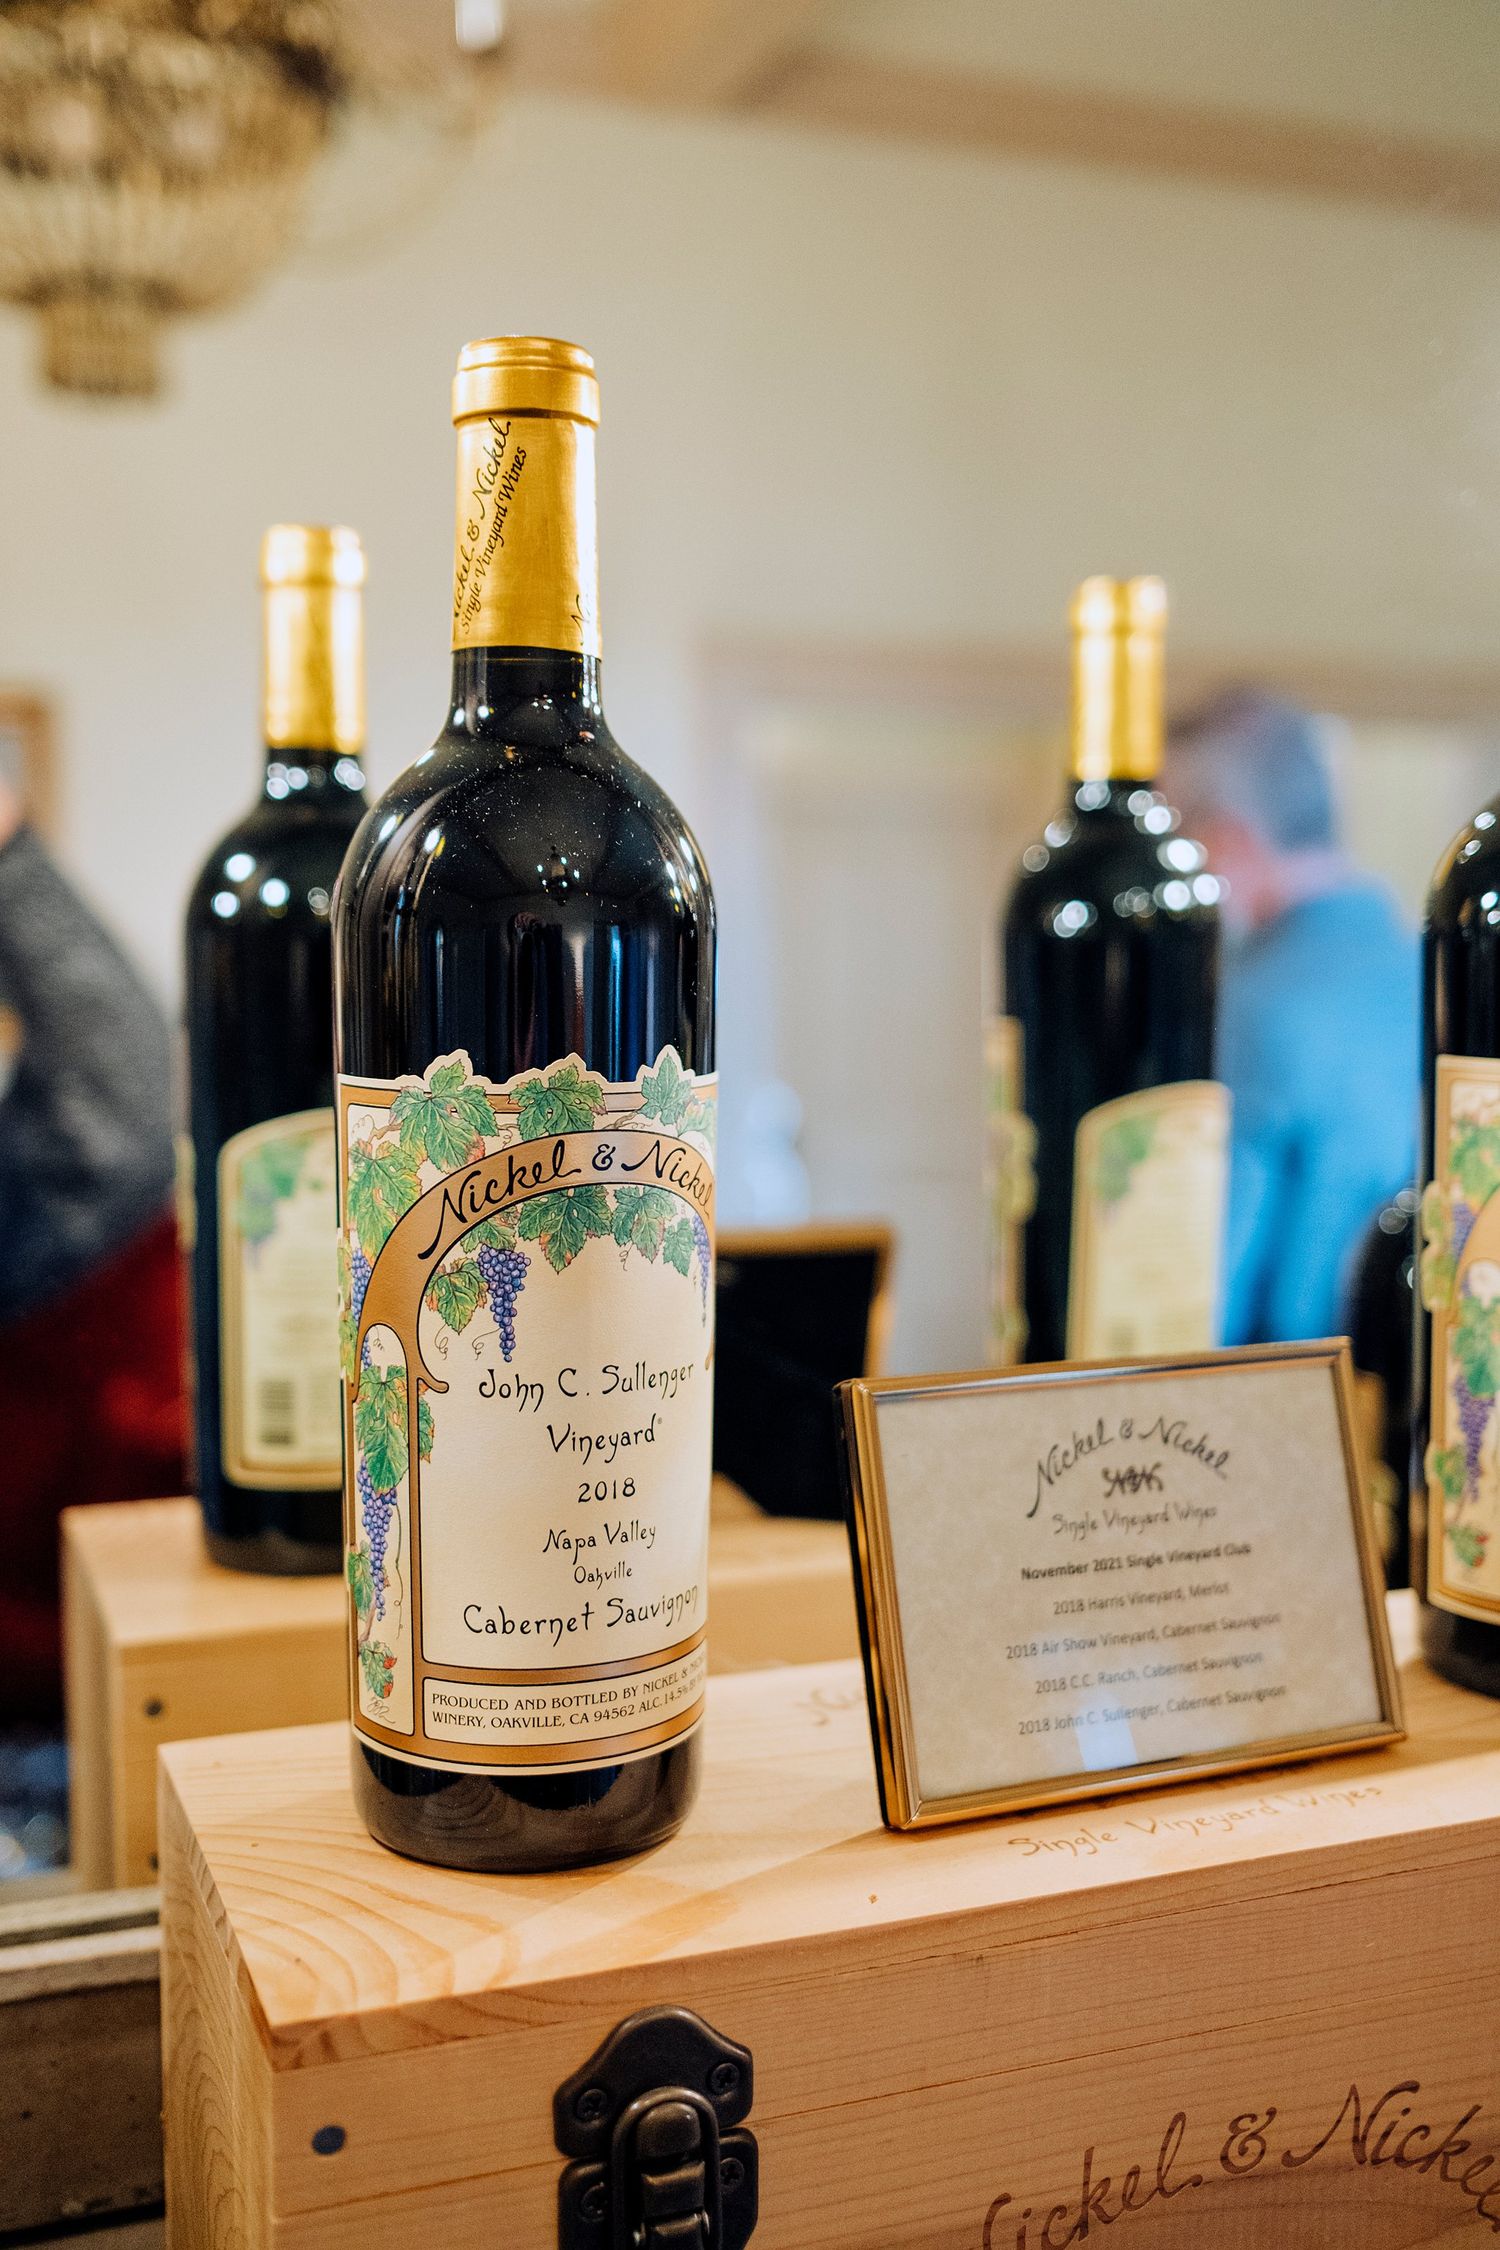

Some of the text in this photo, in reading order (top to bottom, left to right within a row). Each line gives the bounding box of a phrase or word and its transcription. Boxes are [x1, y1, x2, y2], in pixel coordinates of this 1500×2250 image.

[453, 417, 511, 622] ickel & Nickel
[462, 446, 527, 634] Single Vineyard Wines
[418, 1140, 713, 1259] Nickel & Nickel
[479, 1361, 694, 1412] John C. Sullenger
[578, 1477, 637, 1504] 2018
[1026, 1416, 1229, 1518] Nickel & Nickel
[542, 1521, 657, 1565] Napa Valley
[1052, 1501, 1217, 1541] Single Vineyard Wines
[573, 1561, 633, 1589] Oakville
[1021, 1542, 1253, 1580] November 2021 Single Vineyard Club
[463, 1584, 699, 1647] Cabernet Sauvignon
[1053, 1581, 1230, 1616] 2018 Harris Vineyard, Merlot
[1006, 1612, 1281, 1660] 2018 Air Show Vineyard, Cabernet Sauvignon
[432, 1693, 509, 1711] PRODUCED
[514, 1697, 547, 1711] AND
[551, 1690, 618, 1709] BOTTLED
[623, 1686, 639, 1699] BY
[643, 1672, 679, 1694] NICKEL
[1035, 1650, 1264, 1694] 2018 C.C. Ranch, Cabernet Sauvignon
[432, 1711, 486, 1729] WINERY,
[491, 1716, 565, 1729] OAKVILLE,
[569, 1712, 589, 1725] CA
[594, 1705, 635, 1722] 94562
[1018, 1720, 1050, 1736] 2018
[1054, 1713, 1084, 1729] John
[1102, 1703, 1161, 1722] Sullenger,
[1166, 1694, 1222, 1713] Cabernet
[1225, 1684, 1287, 1704] Sauvignon
[1007, 1785, 1383, 1857] Single Vineyard Wines
[1220, 2107, 1277, 2175] &
